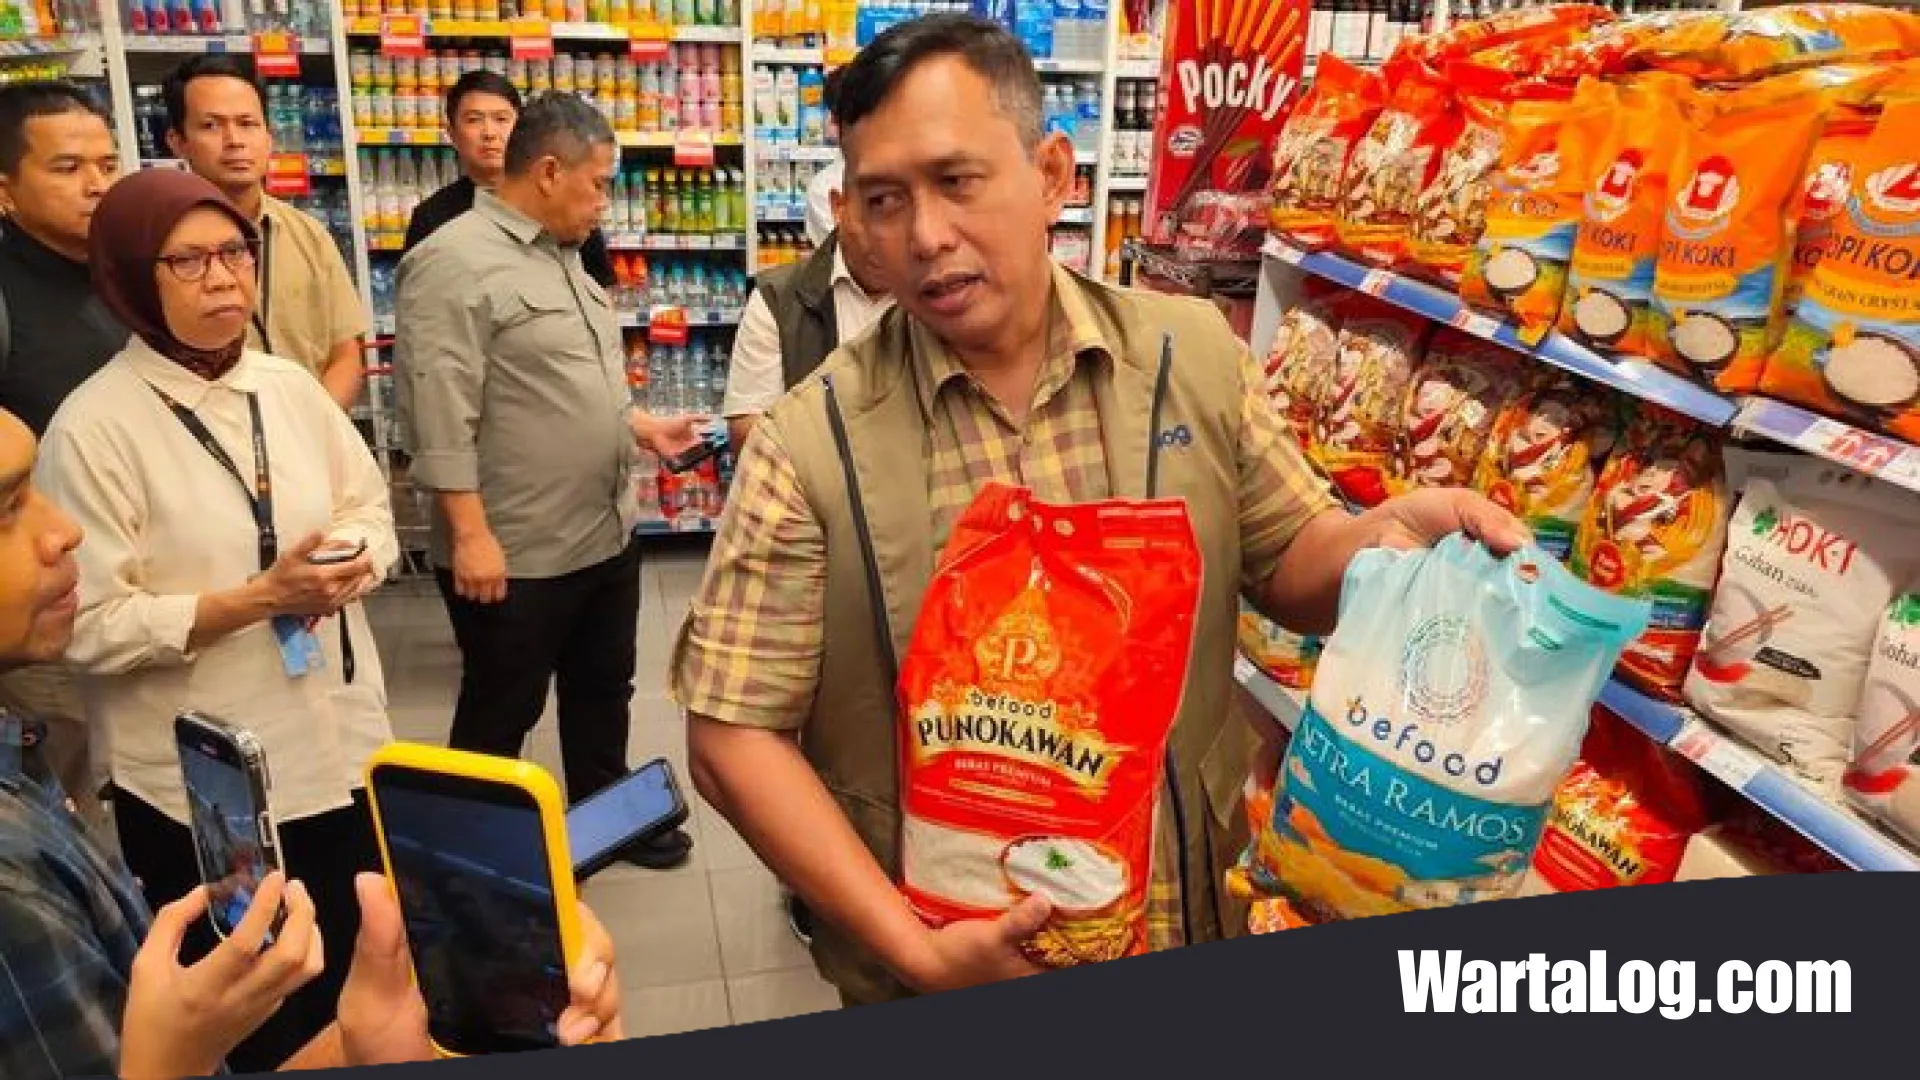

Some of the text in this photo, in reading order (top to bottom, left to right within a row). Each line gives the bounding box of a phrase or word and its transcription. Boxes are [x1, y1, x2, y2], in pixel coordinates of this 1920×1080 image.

[1681, 243, 1736, 269] KOKI
[1793, 244, 1824, 267] KO
[1002, 637, 1038, 679] P
[966, 688, 1054, 719] befood
[918, 714, 1105, 778] PUNOKAWAN
[1346, 695, 1503, 786] befood
[1384, 776, 1526, 843] RAMOS
